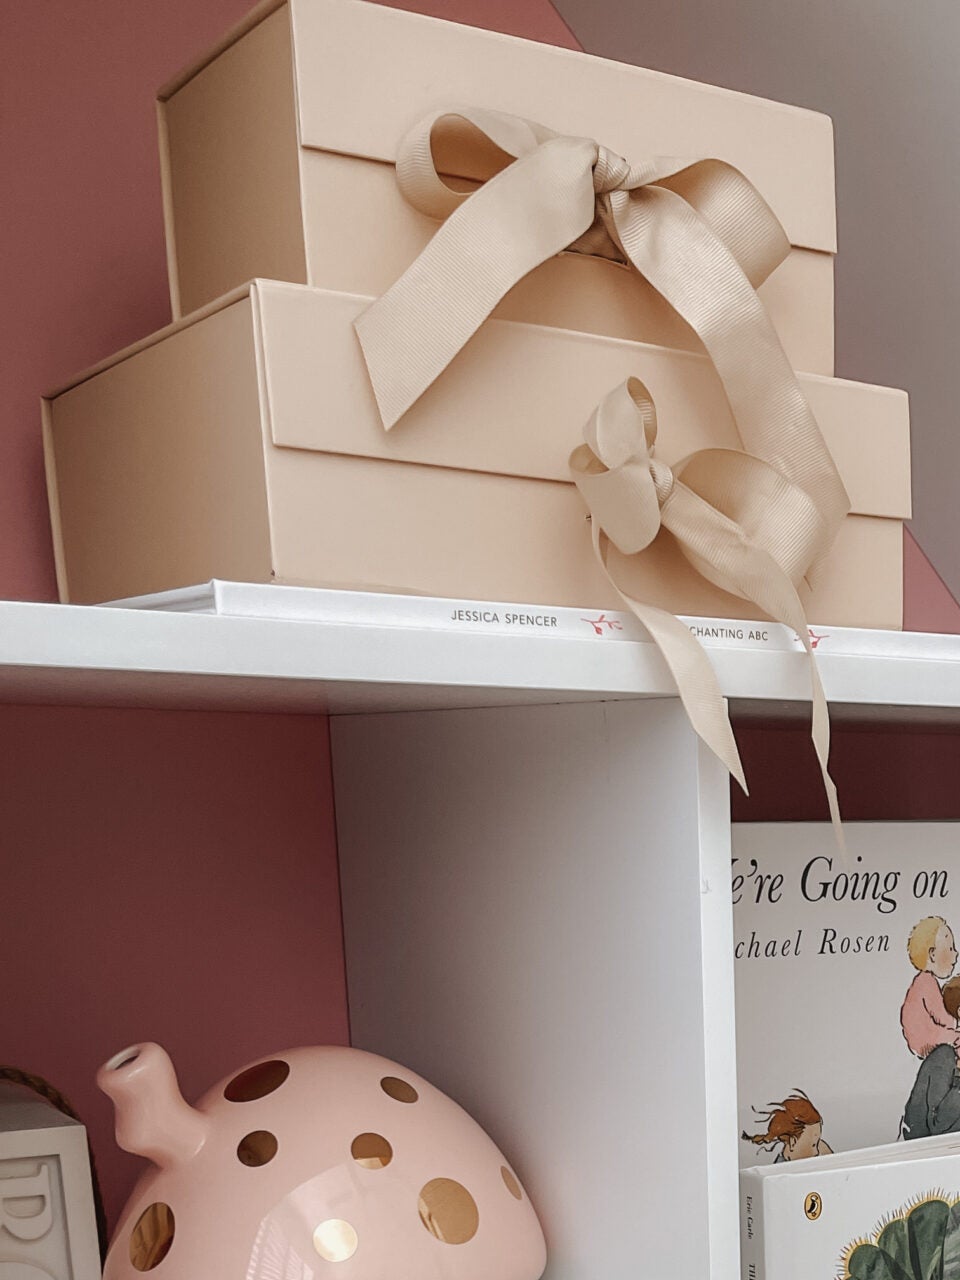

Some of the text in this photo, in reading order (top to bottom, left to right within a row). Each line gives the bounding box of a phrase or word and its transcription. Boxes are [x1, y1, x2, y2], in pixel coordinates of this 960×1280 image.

[451, 610, 557, 627] JESSICA SPENCER
[689, 626, 769, 641] CHANTING ABC
[731, 858, 784, 904] e're
[801, 855, 900, 913] Going
[912, 870, 948, 898] on
[735, 928, 891, 959] chael Rosen
